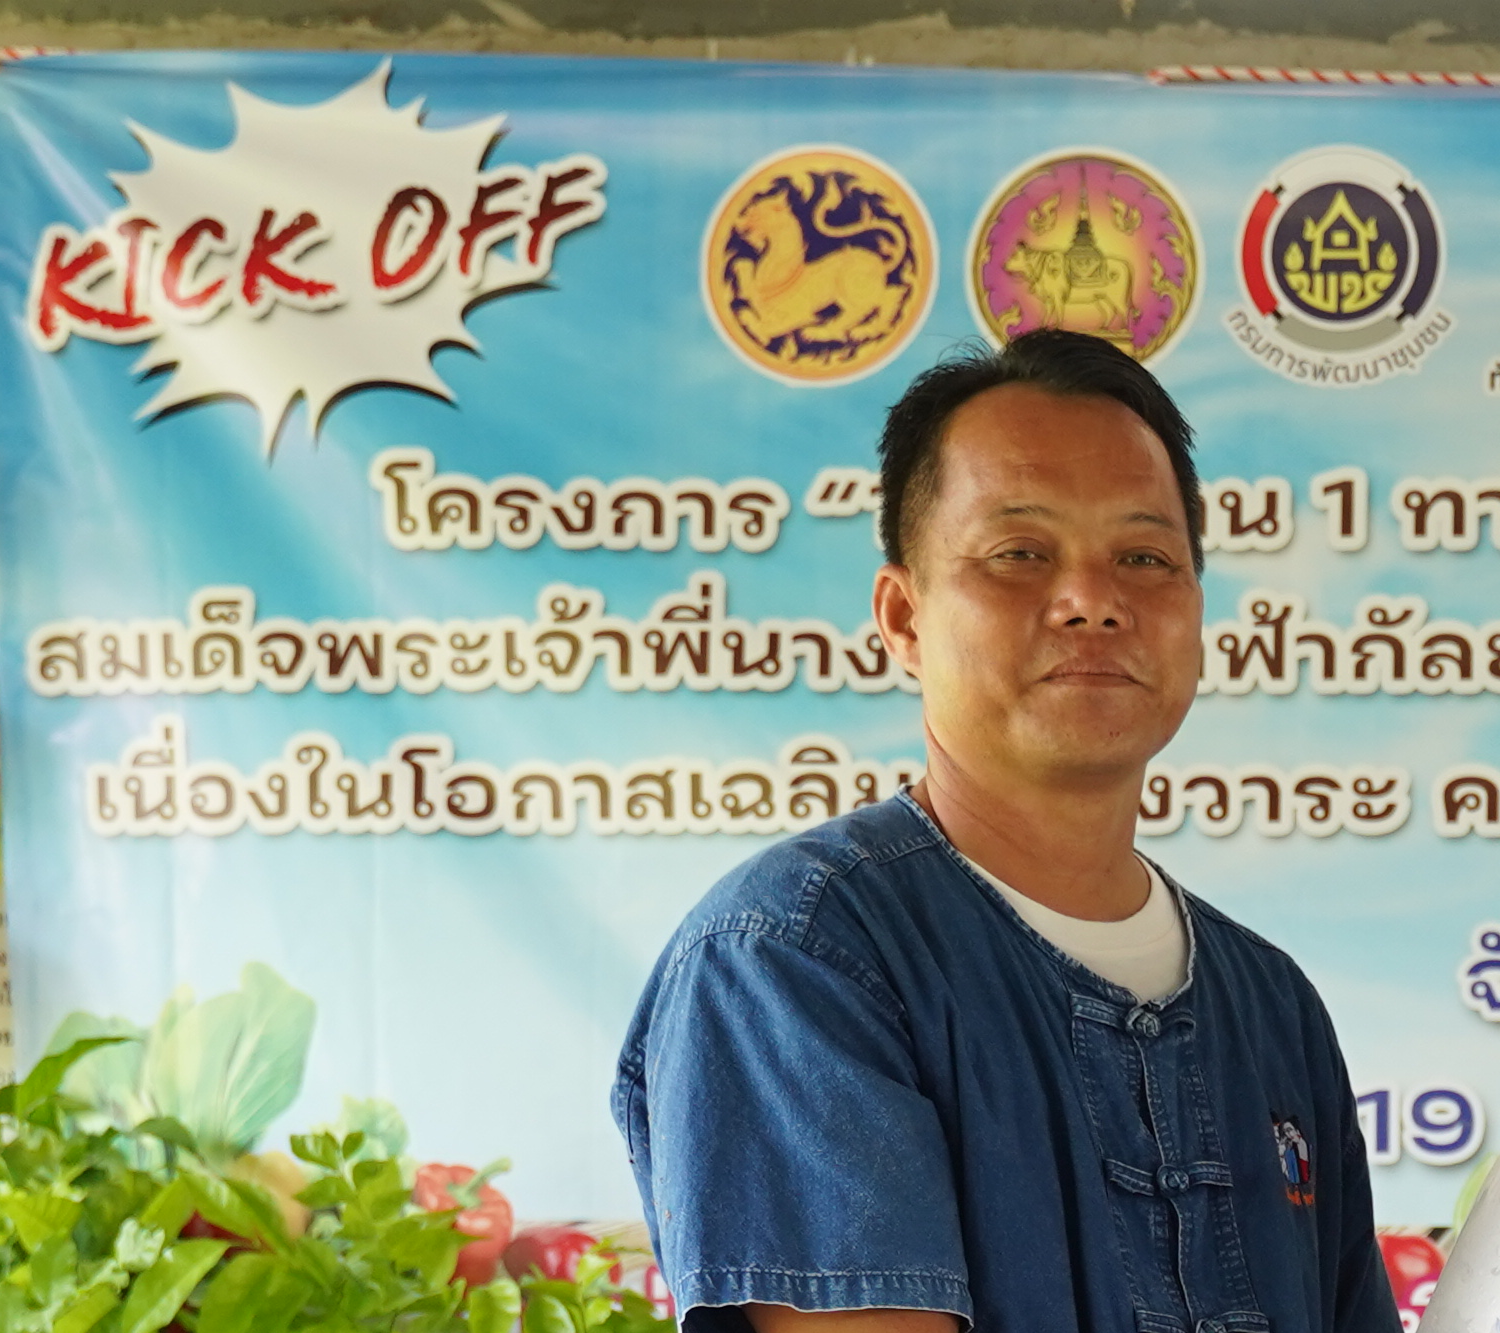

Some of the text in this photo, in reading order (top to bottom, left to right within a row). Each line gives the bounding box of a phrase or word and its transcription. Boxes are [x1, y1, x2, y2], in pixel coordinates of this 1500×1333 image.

[38, 166, 595, 340] KICK OFF
[1226, 308, 1452, 386] กรมการพัฒนาชุมชน
[383, 460, 777, 537] โครงการ
[1322, 479, 1356, 537] 1
[36, 583, 920, 682] สมเด็จพระเจ้าพี่นาง
[1357, 1089, 1474, 1155] 19
